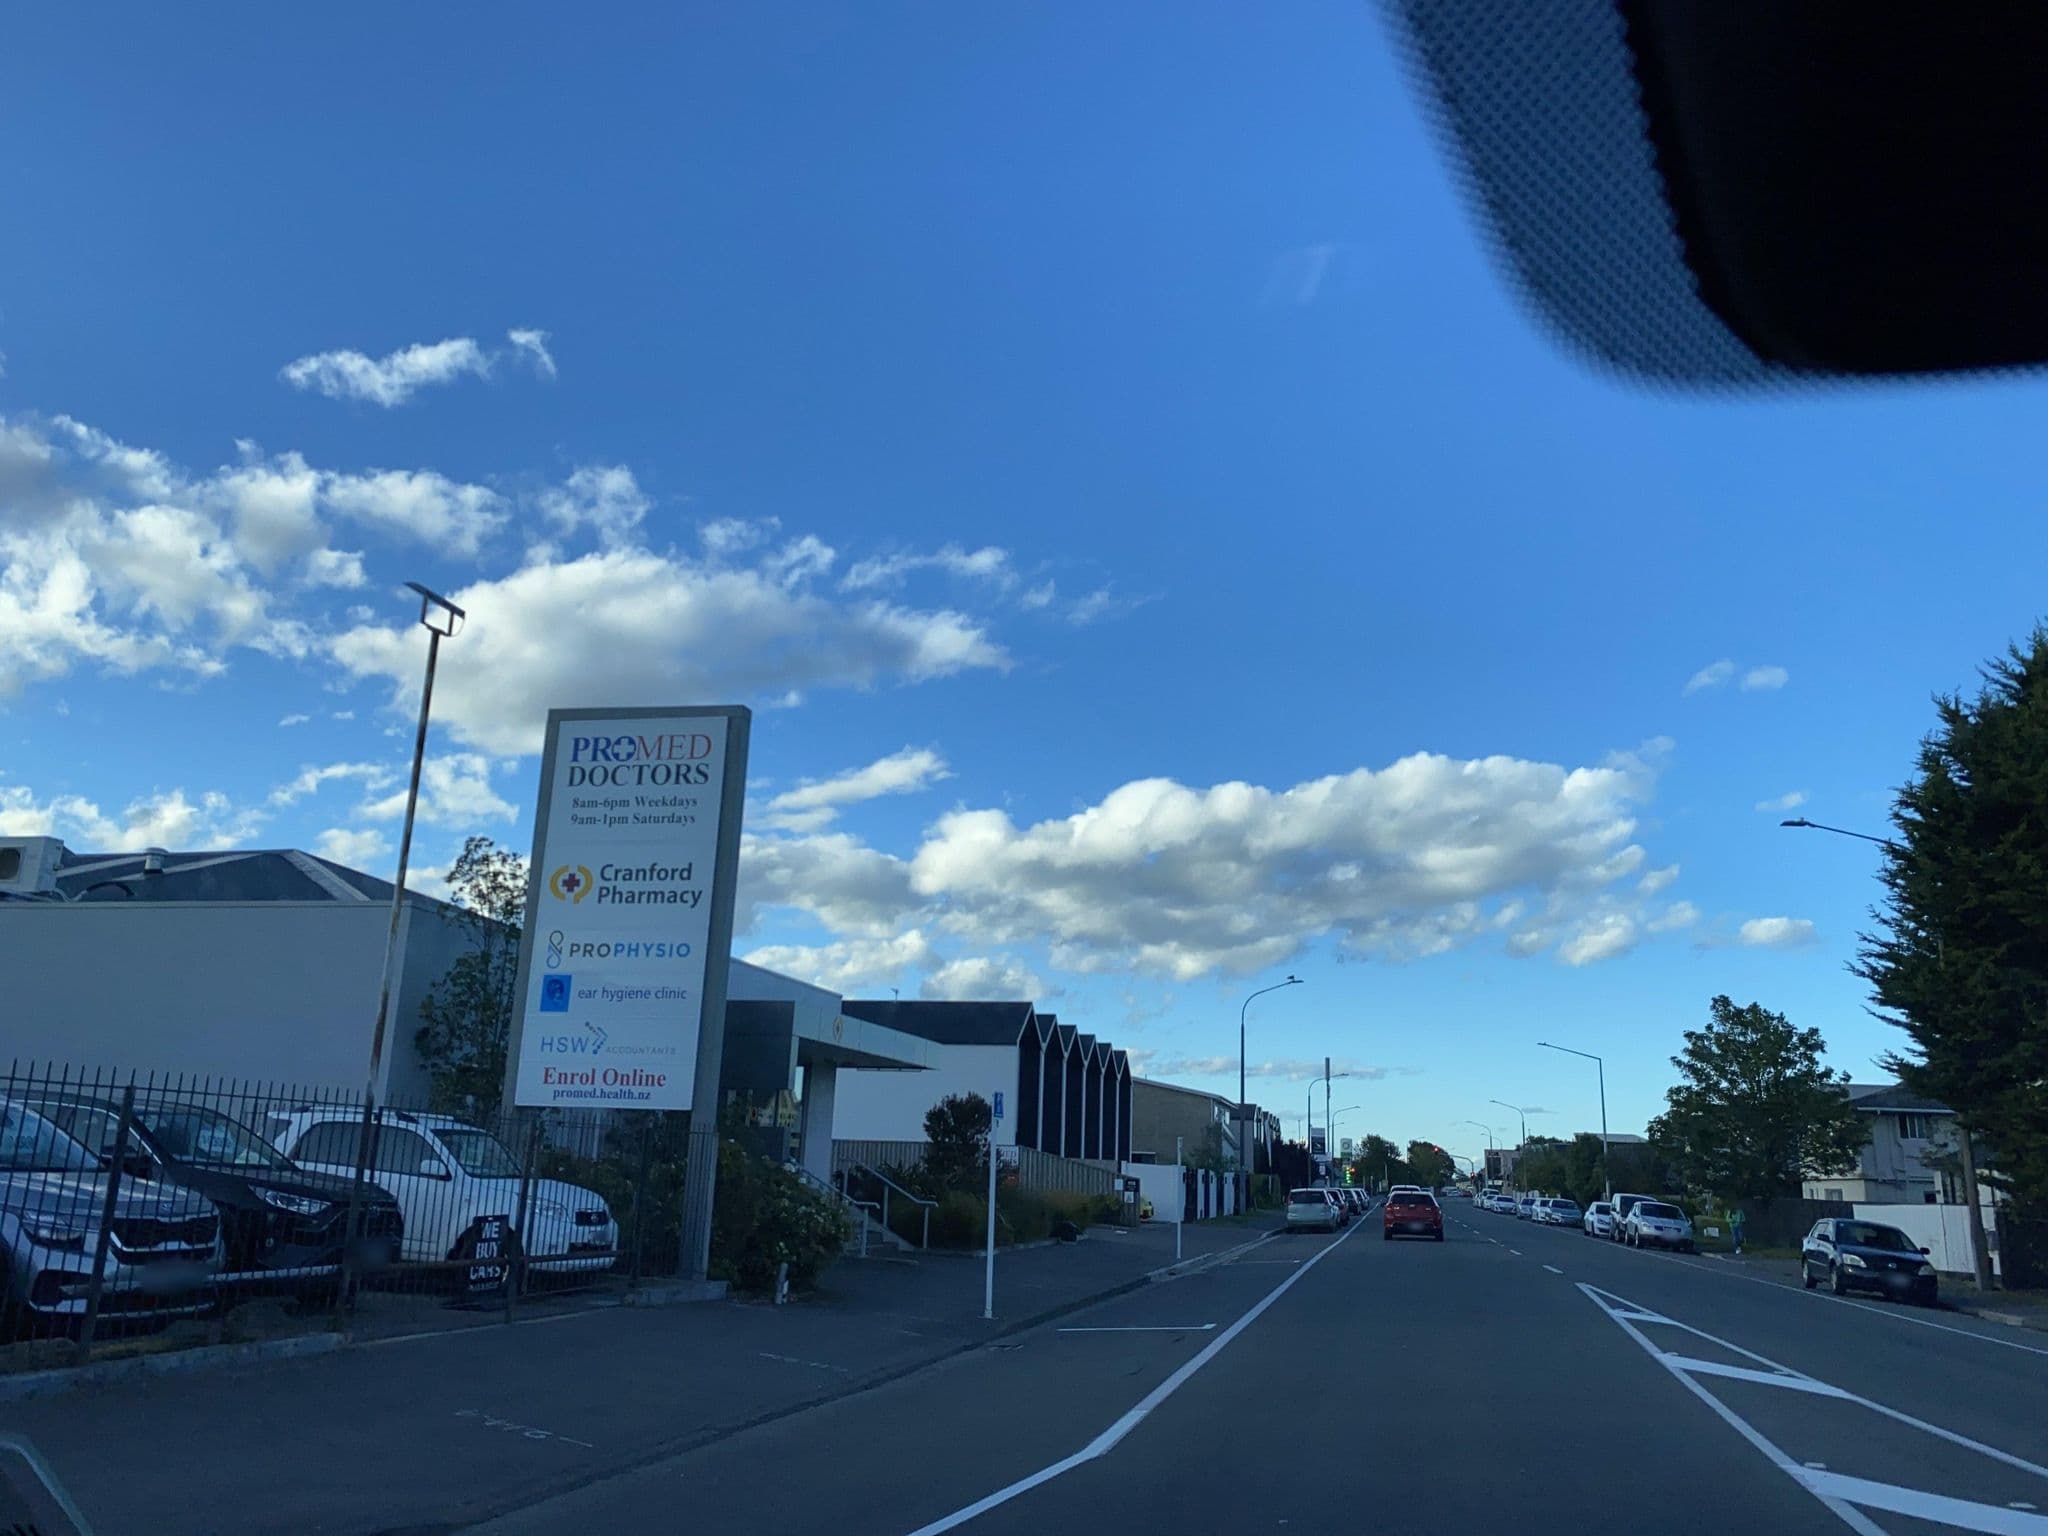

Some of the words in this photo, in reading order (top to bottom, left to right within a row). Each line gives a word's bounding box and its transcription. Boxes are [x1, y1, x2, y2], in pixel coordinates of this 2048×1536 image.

[570, 734, 712, 762] PROMED
[568, 762, 710, 787] DOCTORS
[572, 797, 630, 810] 8am-6pm
[635, 796, 698, 809] Weekdays
[571, 814, 629, 828] 9am-1pm
[632, 812, 695, 826] Saturdays
[600, 862, 693, 882] Cranford
[598, 886, 703, 908] Pharmacy
[569, 942, 691, 958] PROPHYSIO
[578, 989, 597, 999] ear
[601, 987, 651, 1002] hygiene
[655, 987, 687, 999] clinic
[540, 1036, 590, 1053] HSW
[606, 1045, 676, 1055] ACCOUNTANTS
[543, 1067, 596, 1085] Enrol
[603, 1068, 667, 1087] Online
[553, 1088, 651, 1101] promed.health.nz
[482, 1222, 500, 1238] WE
